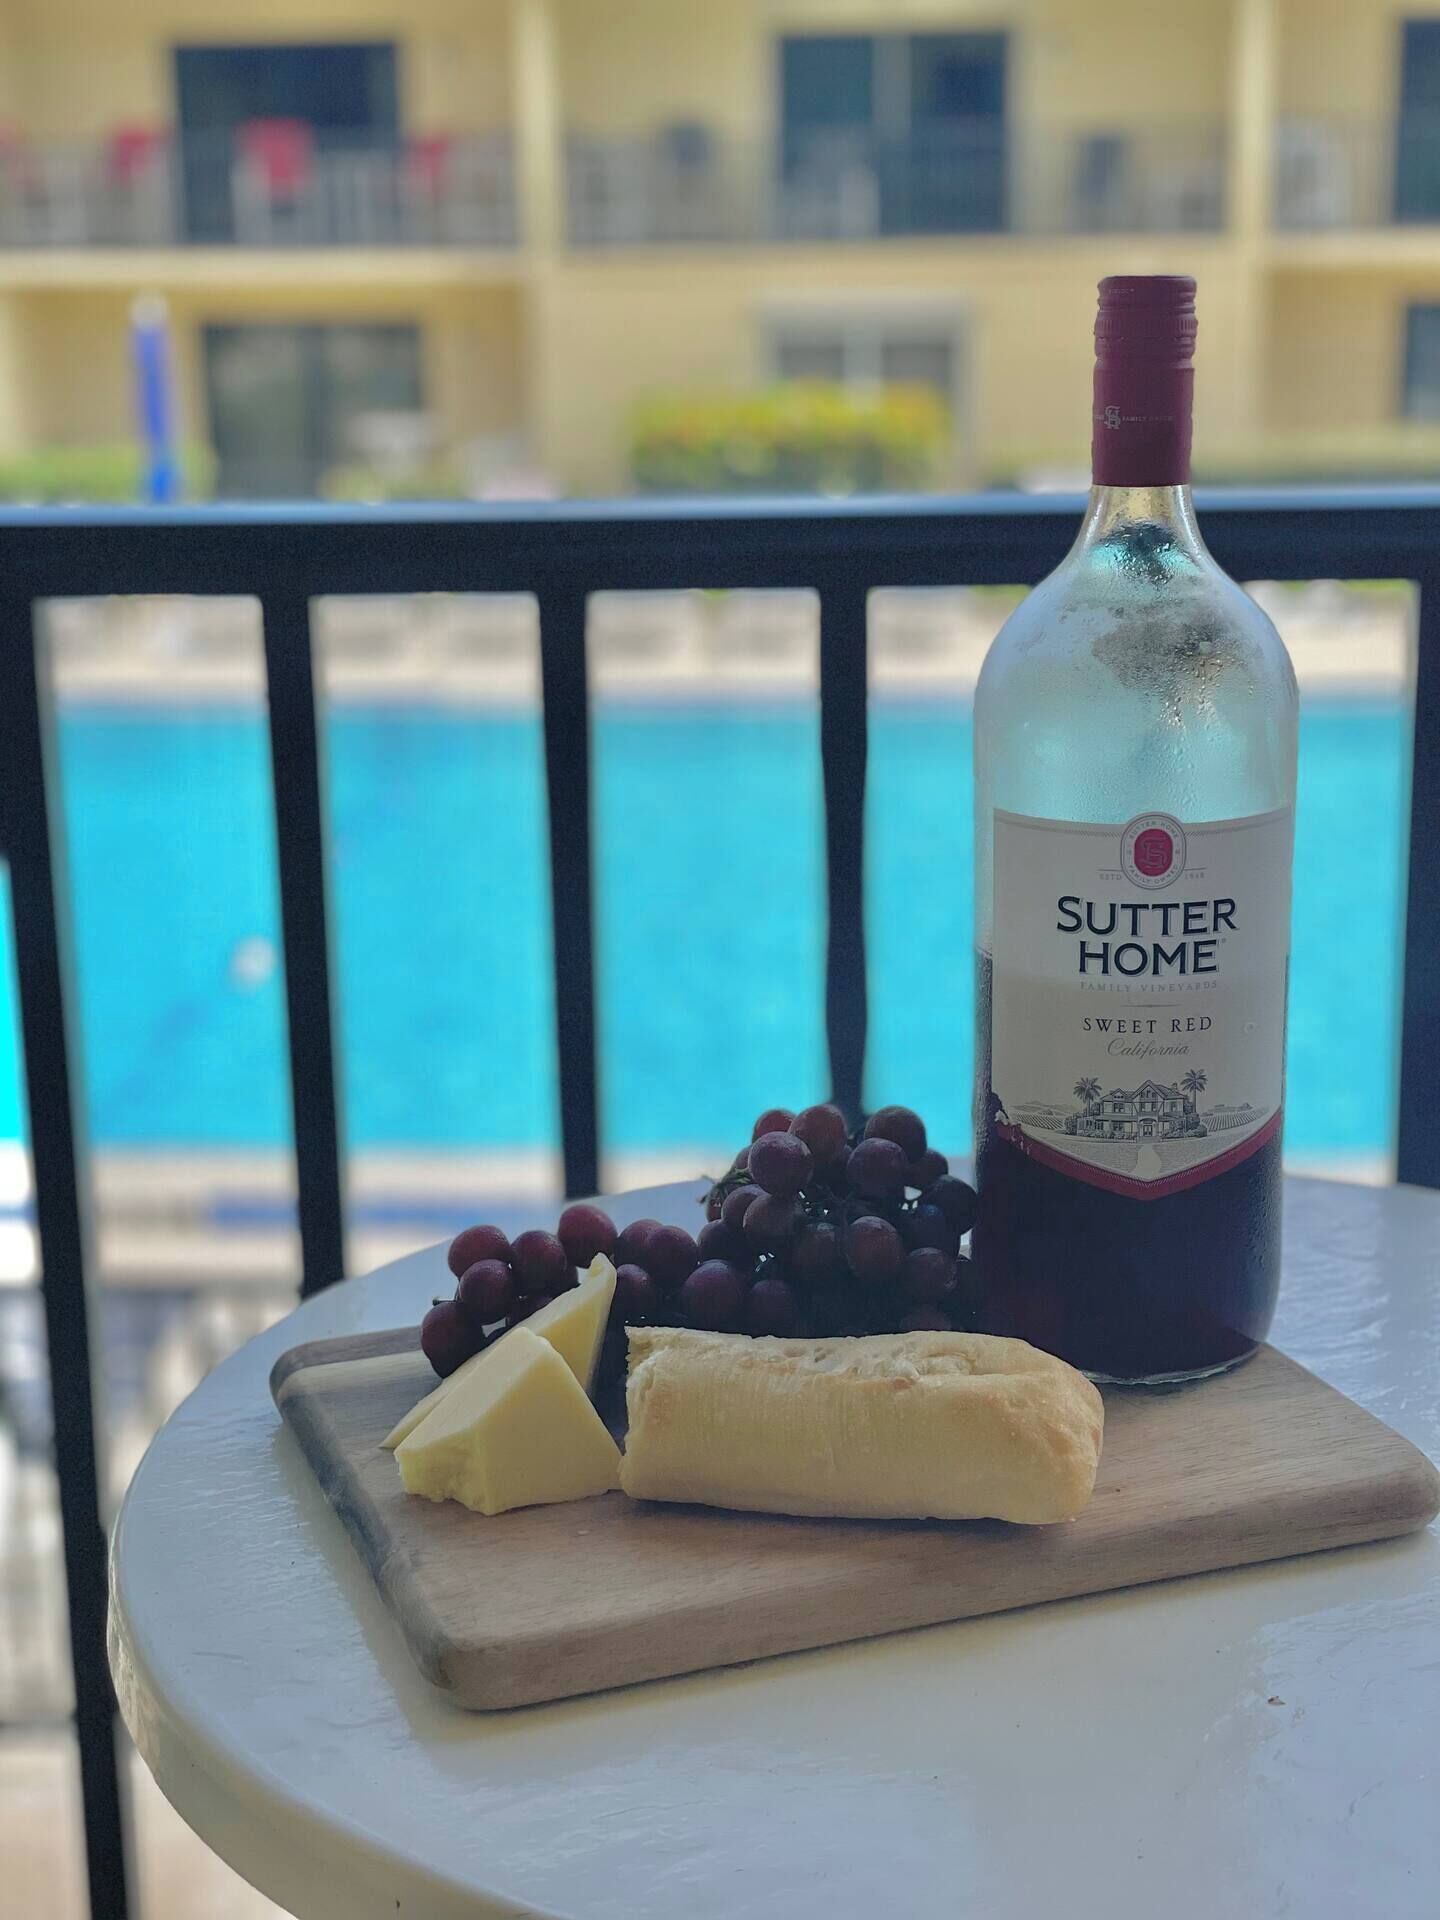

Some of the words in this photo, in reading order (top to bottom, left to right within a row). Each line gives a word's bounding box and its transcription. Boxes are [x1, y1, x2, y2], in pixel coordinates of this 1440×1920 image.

[1057, 896, 1238, 936] SUTTER
[1079, 939, 1219, 976] HOME
[1081, 981, 1131, 992] FAMILY
[1140, 980, 1217, 992] VINEYARDS
[1083, 1017, 1156, 1033] SWEET
[1171, 1016, 1212, 1032] RED
[1107, 1038, 1190, 1059] California
